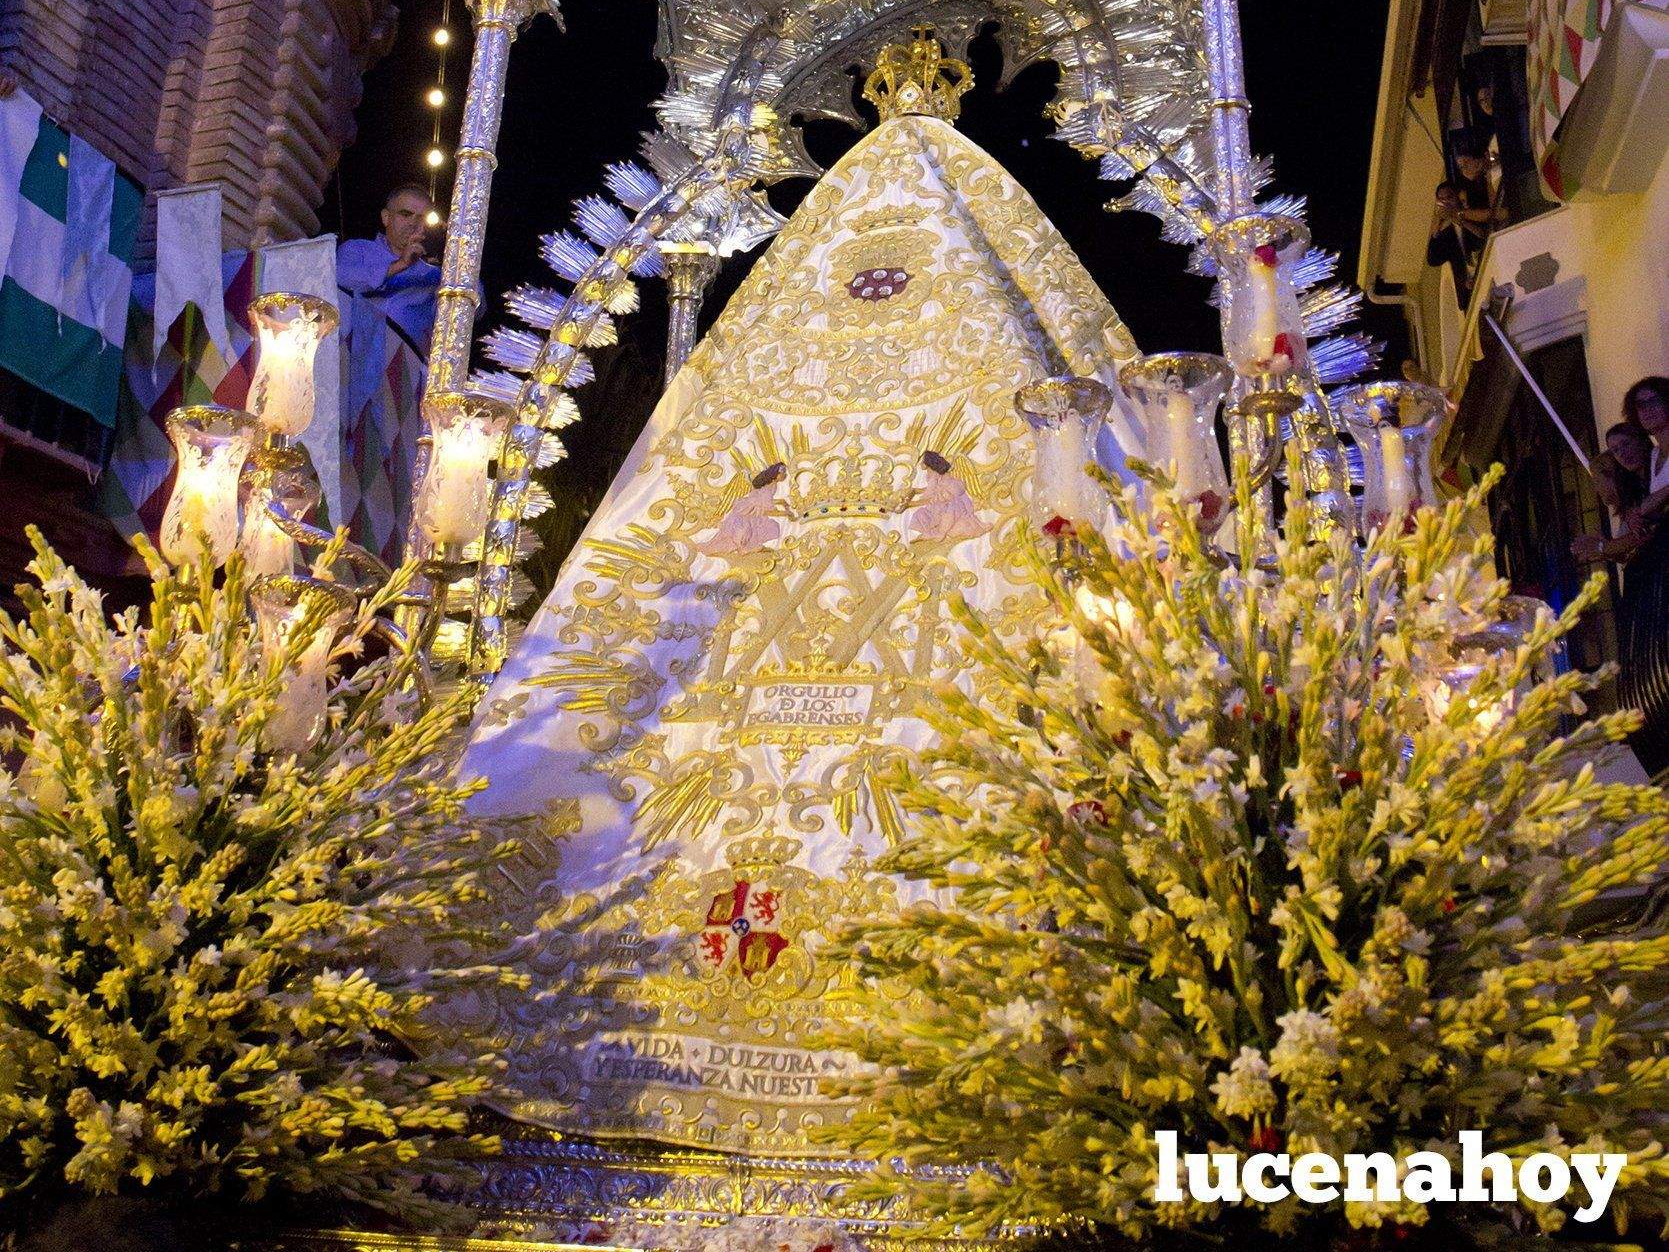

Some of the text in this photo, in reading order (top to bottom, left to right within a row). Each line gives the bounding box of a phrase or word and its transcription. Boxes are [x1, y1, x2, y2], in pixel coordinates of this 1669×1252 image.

[764, 685, 857, 698] ORGULLO
[802, 699, 836, 712] LOS
[747, 712, 864, 725] EGABRENSES
[627, 1037, 816, 1073] VIDA DULZURA
[741, 1072, 816, 1095] NUEST
